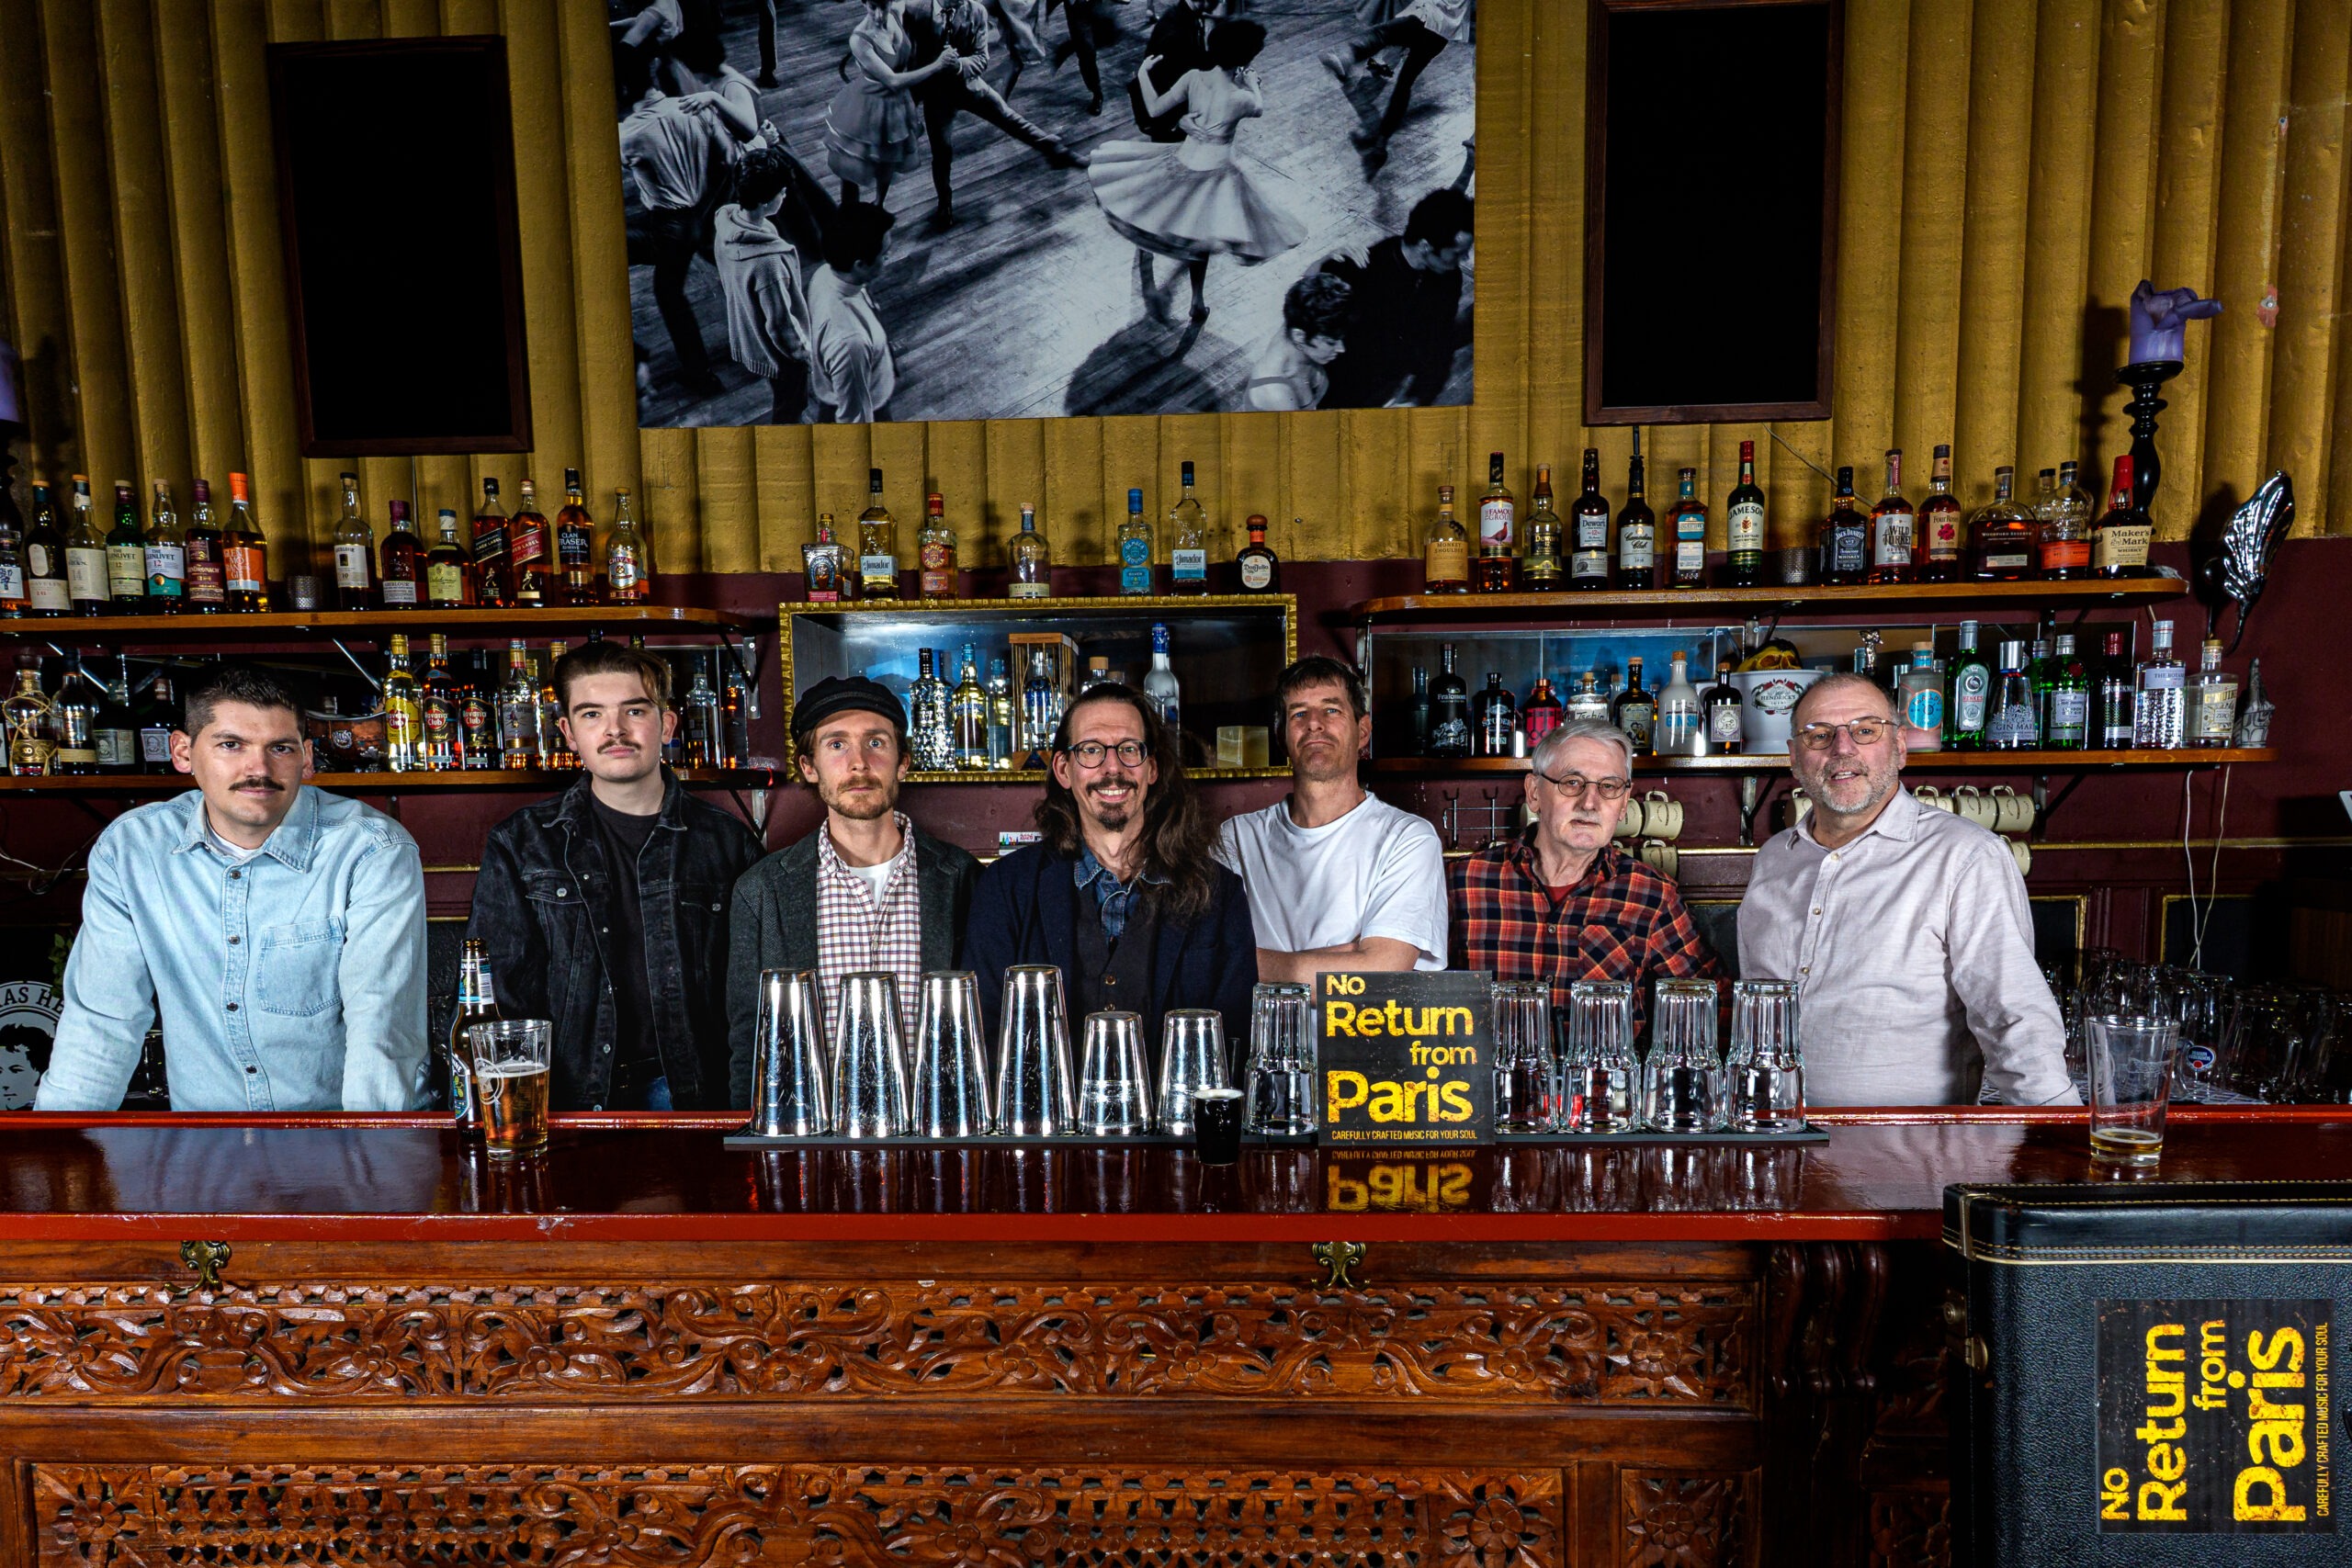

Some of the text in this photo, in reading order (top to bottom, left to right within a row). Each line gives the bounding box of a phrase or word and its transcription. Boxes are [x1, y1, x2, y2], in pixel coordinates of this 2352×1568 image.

[1729, 505, 1763, 520] JAMESON
[424, 711, 447, 719] Havana
[426, 718, 443, 728] Club
[462, 711, 486, 719] Havana
[465, 718, 481, 728] Club
[1326, 975, 1366, 995] No
[0, 987, 28, 1007] AS
[1326, 999, 1475, 1037] Return
[1409, 1041, 1477, 1066] from
[1327, 1066, 1474, 1123] Paris
[1331, 1129, 1477, 1140] CAREFULLY CRAFTED MUSIC FOR YOUR SOUL
[2192, 1319, 2227, 1411] from
[2136, 1324, 2187, 1521] Return
[2228, 1326, 2306, 1521] Paris
[2315, 1322, 2329, 1517] CAREFULLY CRAFTED MUSIC FOR YOUR SOUL
[2100, 1468, 2130, 1520] No
